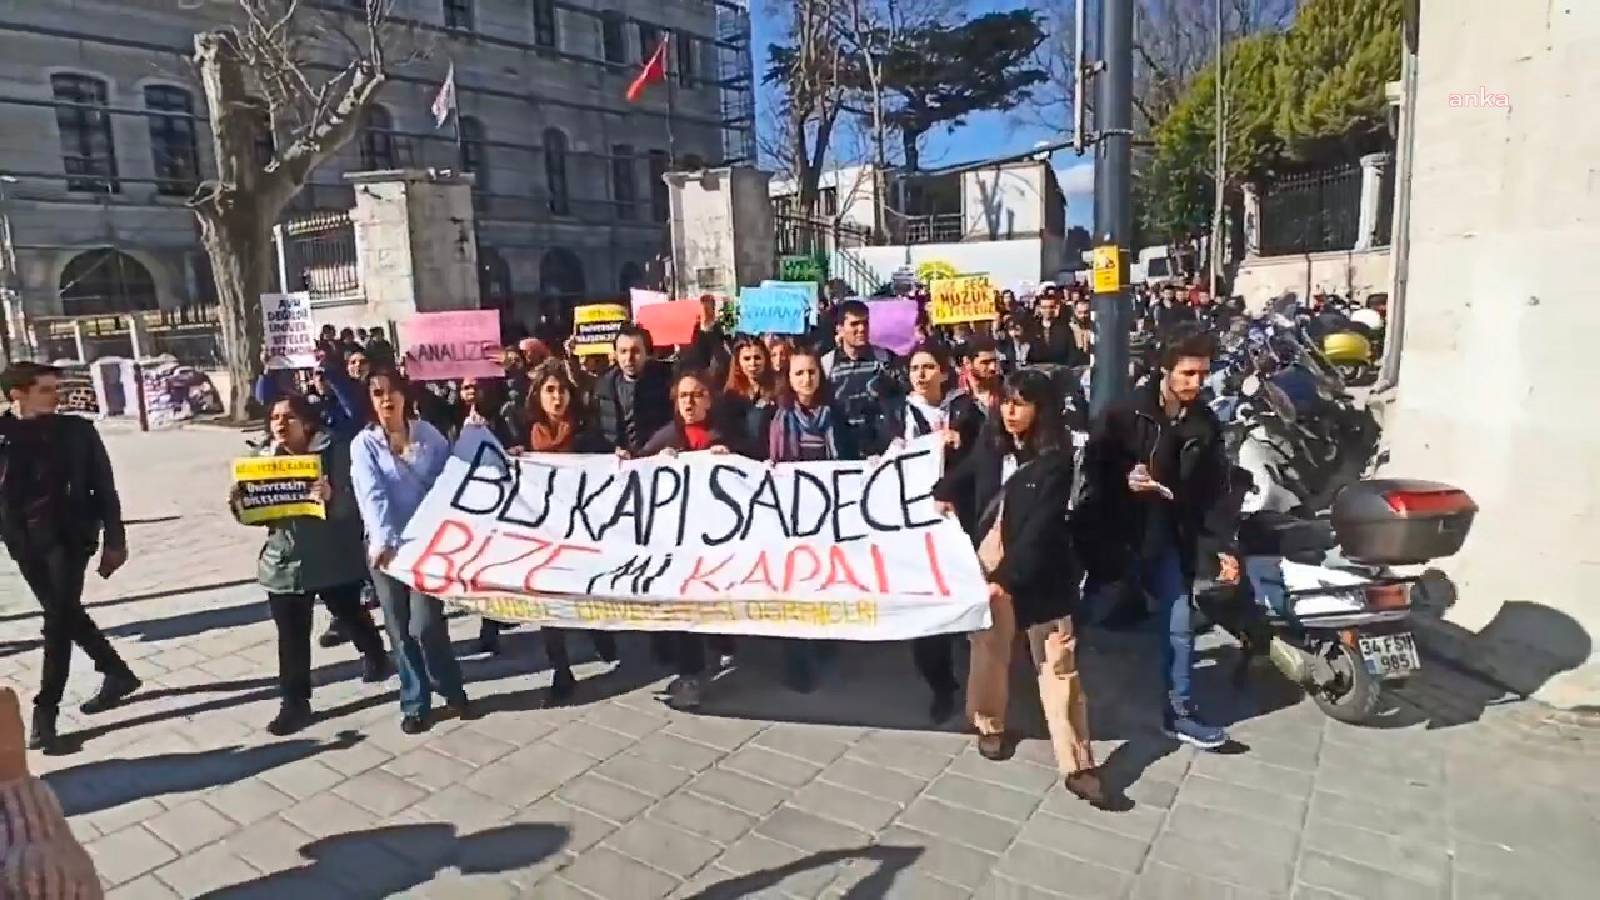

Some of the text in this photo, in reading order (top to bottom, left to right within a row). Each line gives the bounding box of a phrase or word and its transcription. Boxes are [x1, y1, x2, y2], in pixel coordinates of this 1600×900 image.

[450, 440, 943, 547] BU KAPI SADECE
[679, 530, 951, 597] KAPALI
[1361, 639, 1382, 656] 34
[1380, 652, 1411, 671] 985
